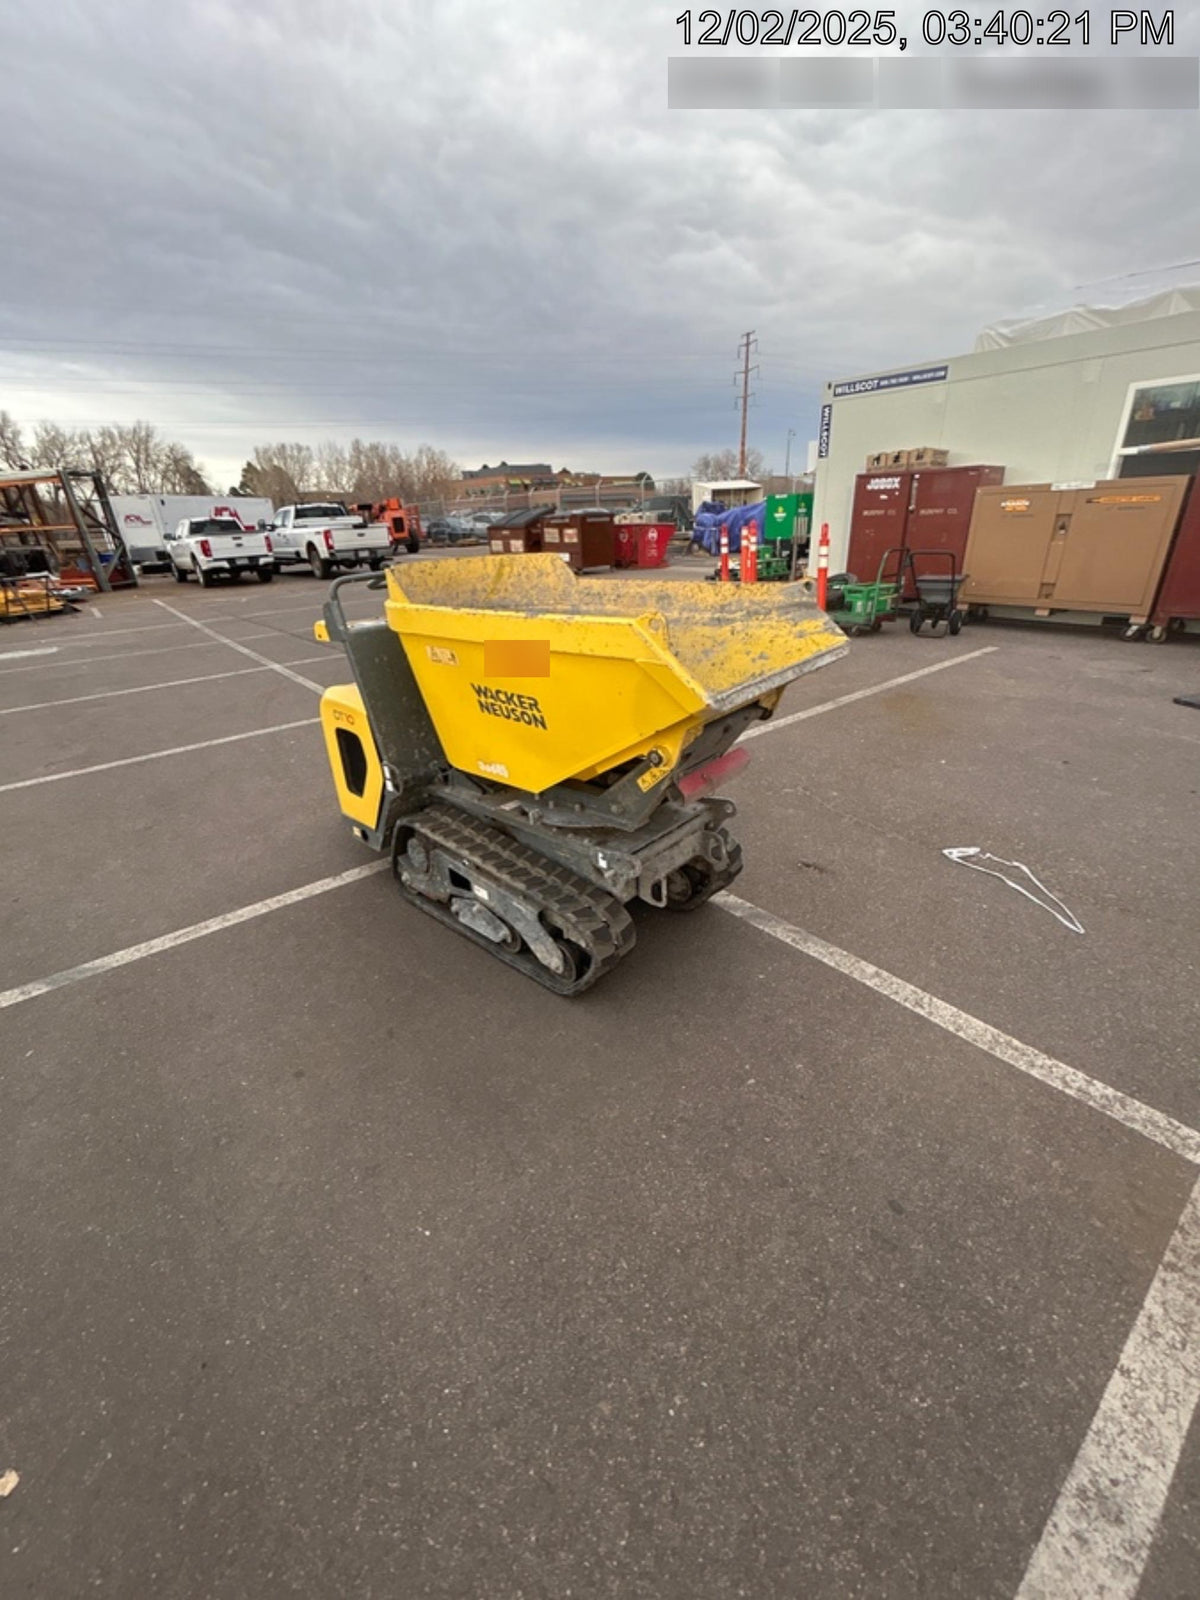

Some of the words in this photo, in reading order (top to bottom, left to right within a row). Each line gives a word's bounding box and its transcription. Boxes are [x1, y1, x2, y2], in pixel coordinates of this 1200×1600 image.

[835, 379, 879, 396] WILLSCOT
[820, 406, 831, 457] WILLSCOT
[470, 682, 543, 714] WACKER
[477, 698, 548, 731] NEUSON
